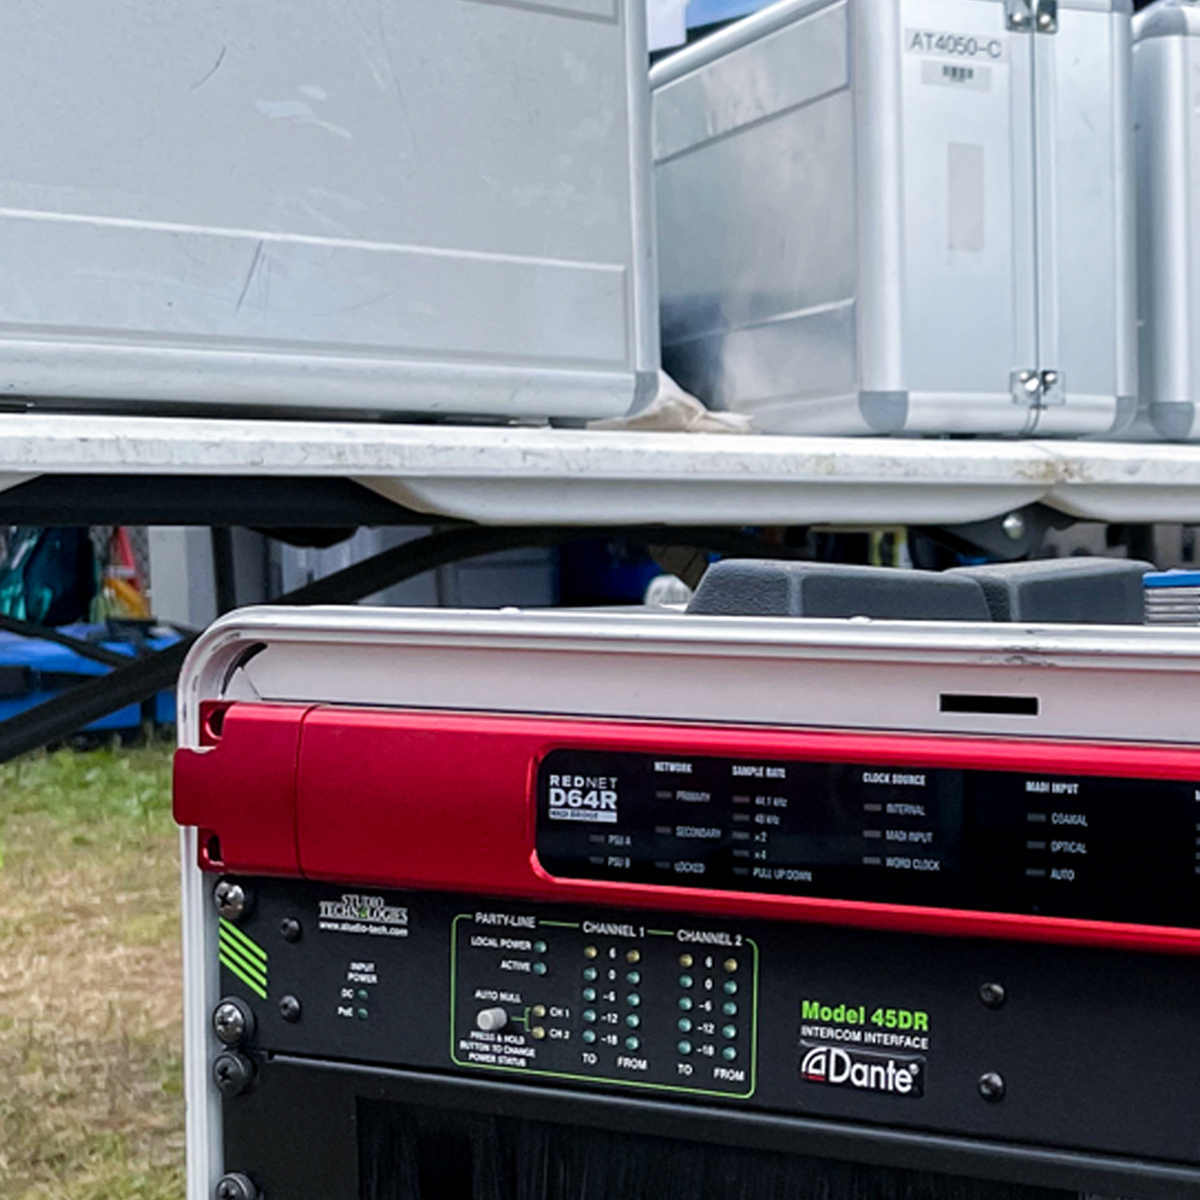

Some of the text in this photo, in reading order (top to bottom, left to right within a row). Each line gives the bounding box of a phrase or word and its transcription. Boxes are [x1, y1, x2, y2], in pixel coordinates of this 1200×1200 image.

[911, 31, 1002, 59] AT4050-C
[549, 774, 618, 790] REDNET
[862, 772, 891, 785] CLOCK
[549, 787, 618, 810] D64R
[1050, 868, 1075, 881] AUTO
[341, 894, 385, 908] STUDIO
[475, 912, 536, 928] PARTY-LINE
[583, 921, 646, 938] CHANNEL 1
[471, 936, 532, 952] LOCAL POWER
[677, 929, 743, 947] CHANNEL 2
[500, 960, 531, 973] ACTIVE
[347, 972, 378, 984] POWER
[801, 1000, 929, 1032] Model 45DR
[801, 1025, 929, 1051] INTERCOM INTERFACE
[583, 1053, 597, 1065] TO
[617, 1056, 648, 1070] FROM
[678, 1064, 693, 1076] TO
[713, 1067, 745, 1082] FROM
[828, 1047, 914, 1094] Dante
